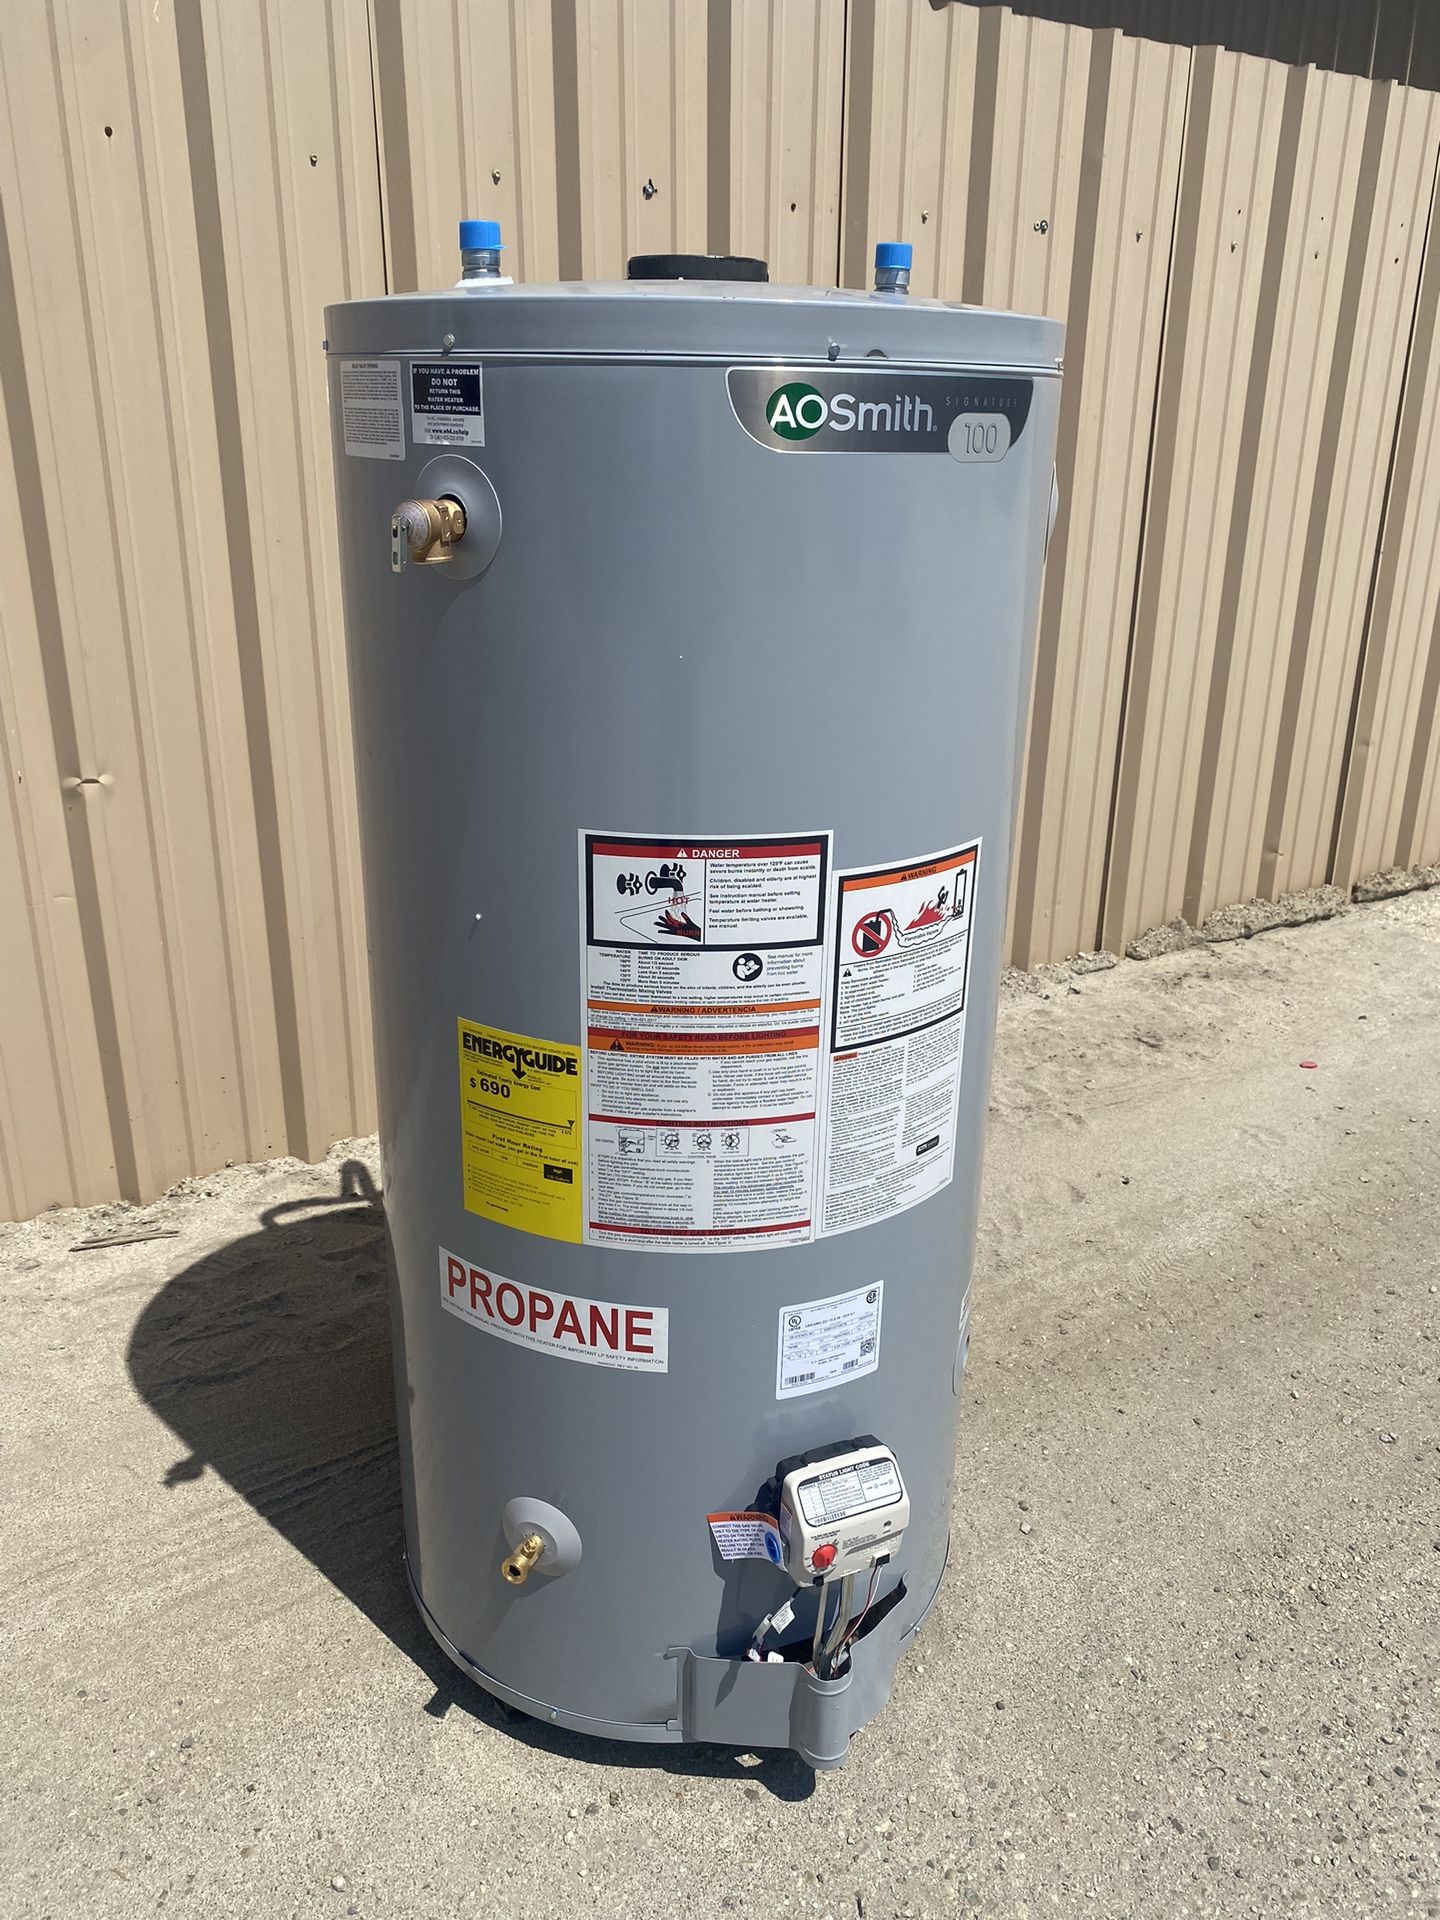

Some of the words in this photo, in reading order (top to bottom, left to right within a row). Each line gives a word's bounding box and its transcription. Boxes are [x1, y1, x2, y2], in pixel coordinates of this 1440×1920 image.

[945, 396, 1018, 408] SIGNATURE
[965, 422, 997, 454] 100
[692, 850, 740, 858] DANGER
[907, 866, 936, 880] WARNING
[463, 1031, 578, 1076] ENERGYGUIDE
[470, 1078, 476, 1088] $
[480, 1078, 511, 1098] 690
[514, 1080, 529, 1089] Energy
[492, 1134, 505, 1142] First
[523, 1143, 543, 1153] Rating
[447, 1256, 654, 1354] PROPANE
[537, 1338, 555, 1348] HEATER
[568, 1347, 596, 1356] IMPORTANT
[819, 1472, 838, 1480] STATUS
